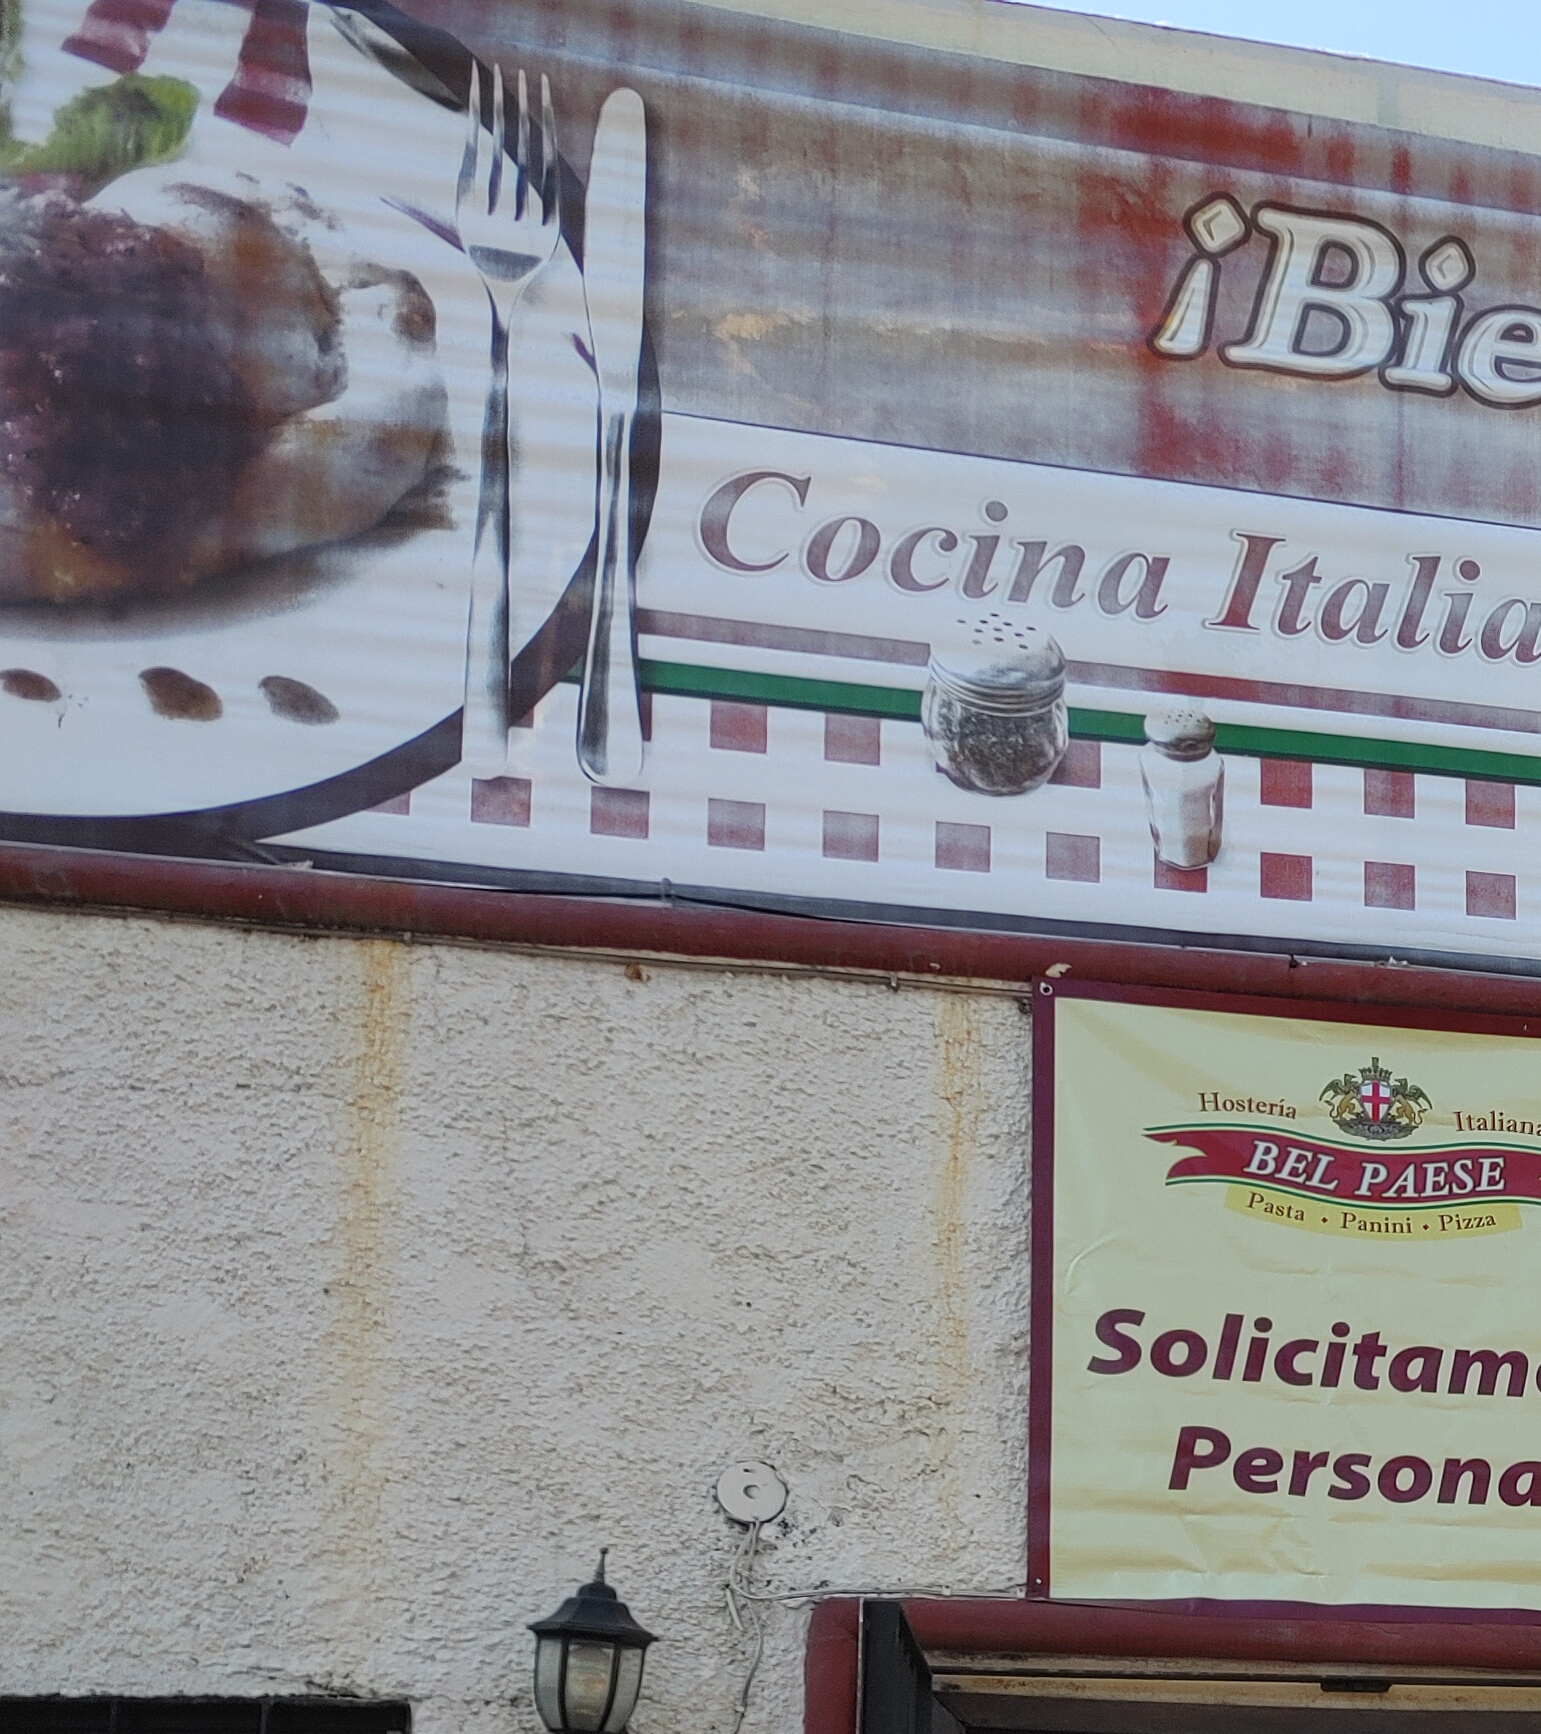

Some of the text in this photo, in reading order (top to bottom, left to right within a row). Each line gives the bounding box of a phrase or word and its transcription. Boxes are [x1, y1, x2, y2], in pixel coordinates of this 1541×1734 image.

[698, 468, 1171, 618] Cocina
[1198, 1091, 1298, 1120] Hostería
[1243, 1139, 1507, 1199] BEL PAESE
[1246, 1190, 1497, 1235] Pasta Panini Pizza
